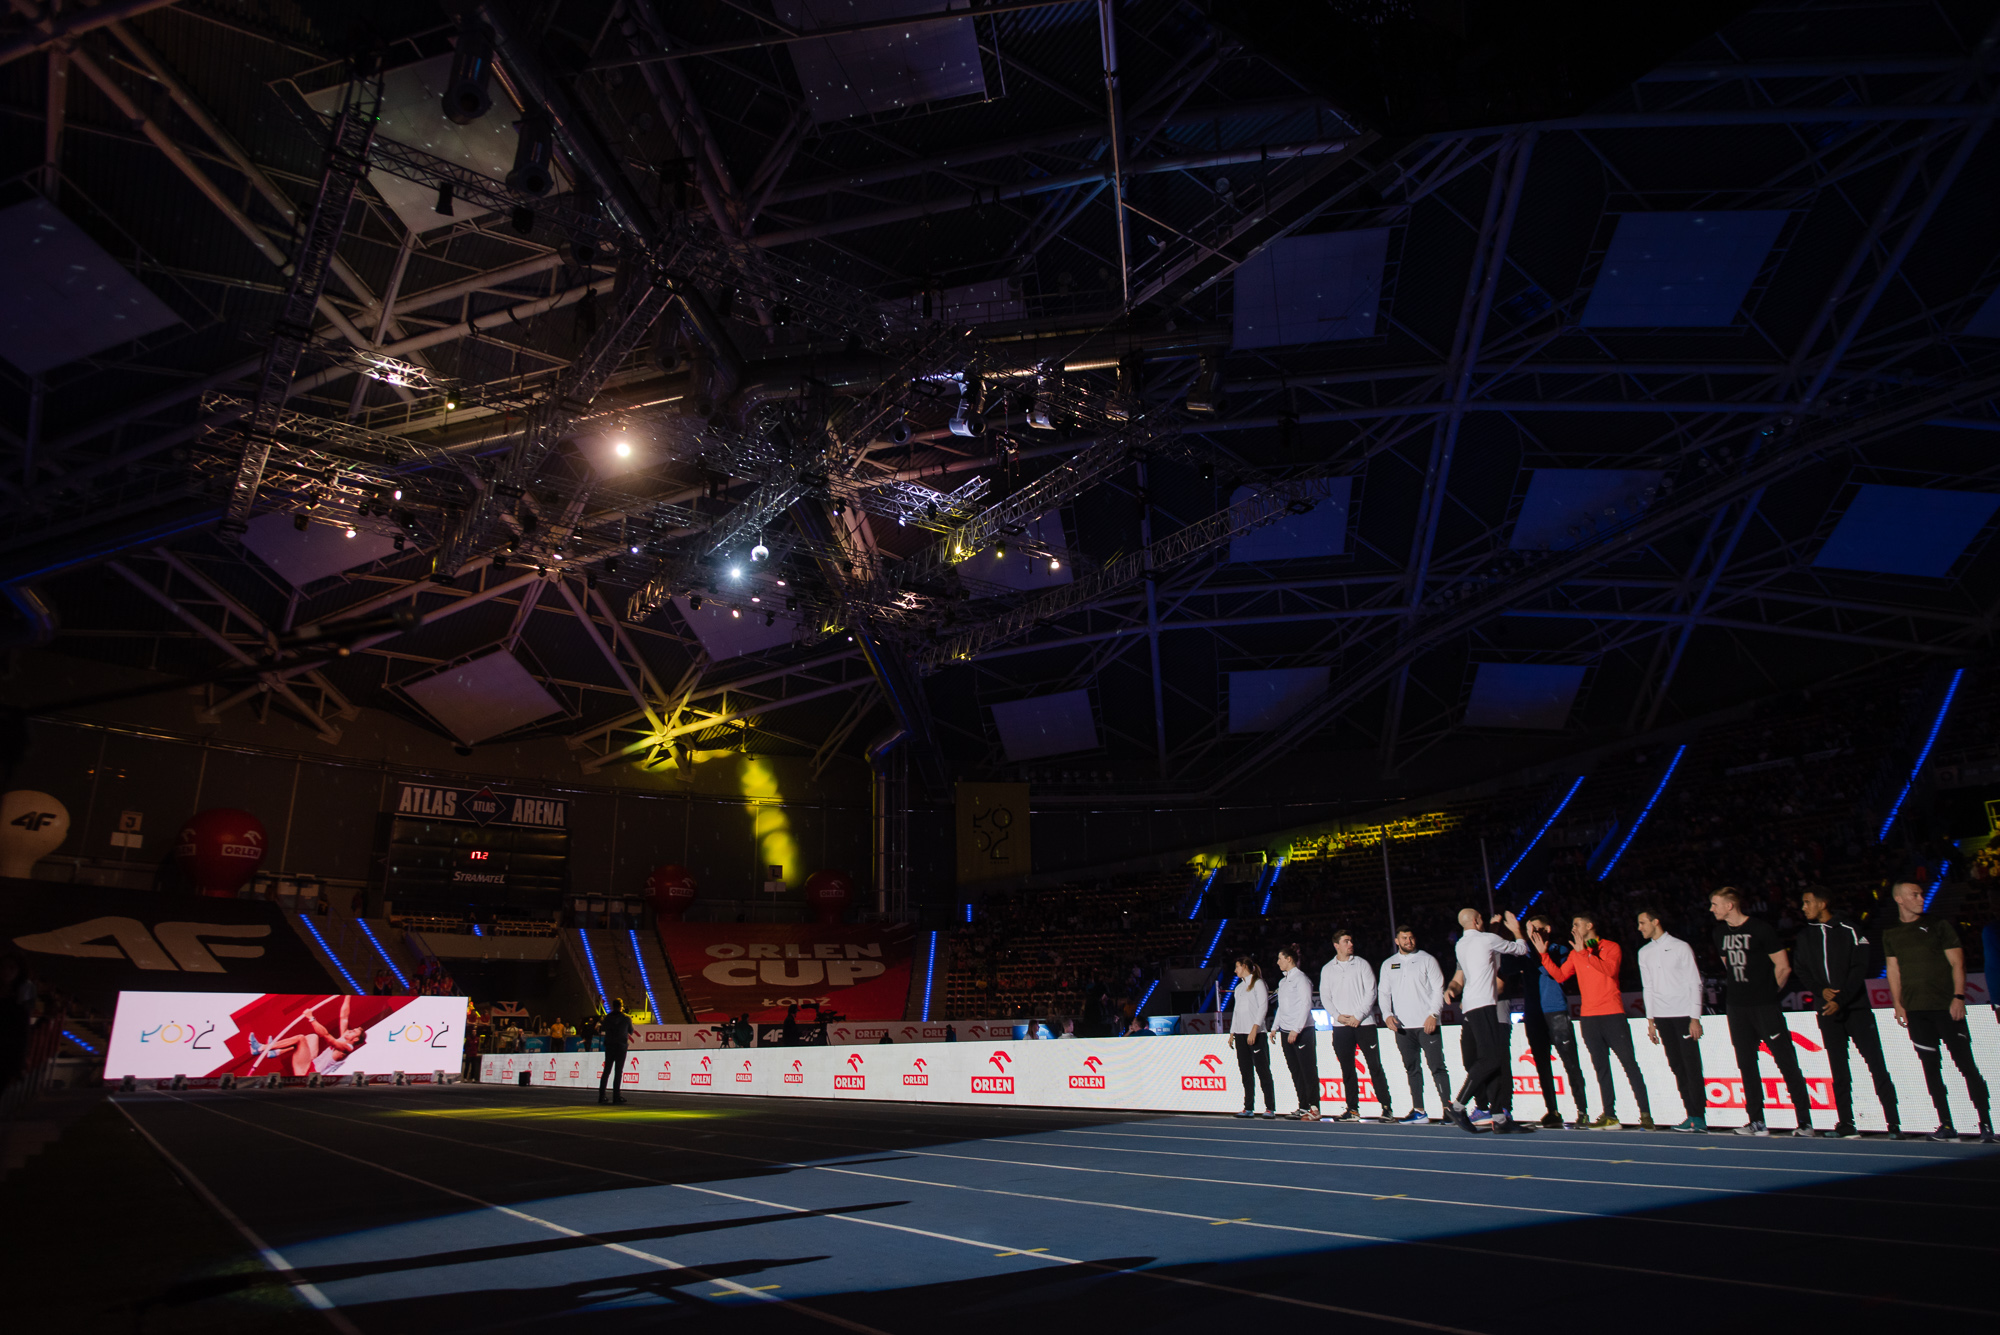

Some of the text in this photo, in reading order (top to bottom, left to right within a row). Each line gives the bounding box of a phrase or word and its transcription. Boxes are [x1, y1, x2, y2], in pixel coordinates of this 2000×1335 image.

[399, 786, 565, 827] ATLAS ATLAS ARENA
[10, 811, 57, 831] 4F
[224, 846, 260, 858] ORLEN
[671, 888, 693, 896] ORLEN
[12, 915, 272, 974] 4F
[1722, 933, 1752, 951] JUST
[705, 943, 883, 959] ORLEN
[1727, 949, 1748, 967] DO
[702, 959, 887, 987] CUP
[646, 1032, 680, 1041] ORLEN
[762, 1028, 784, 1043] 4F
[856, 1029, 888, 1039] ORLEN
[924, 1028, 947, 1037] ORLE
[691, 1075, 710, 1084] ORLEN
[785, 1075, 802, 1083] ORLEN
[835, 1077, 864, 1089] ORLEN
[904, 1076, 927, 1084] ORLEN
[972, 1078, 1012, 1093] ORLEN
[1070, 1077, 1103, 1088] ORLEN
[1183, 1077, 1225, 1090] ORLEN
[1513, 1078, 1559, 1092] RLE
